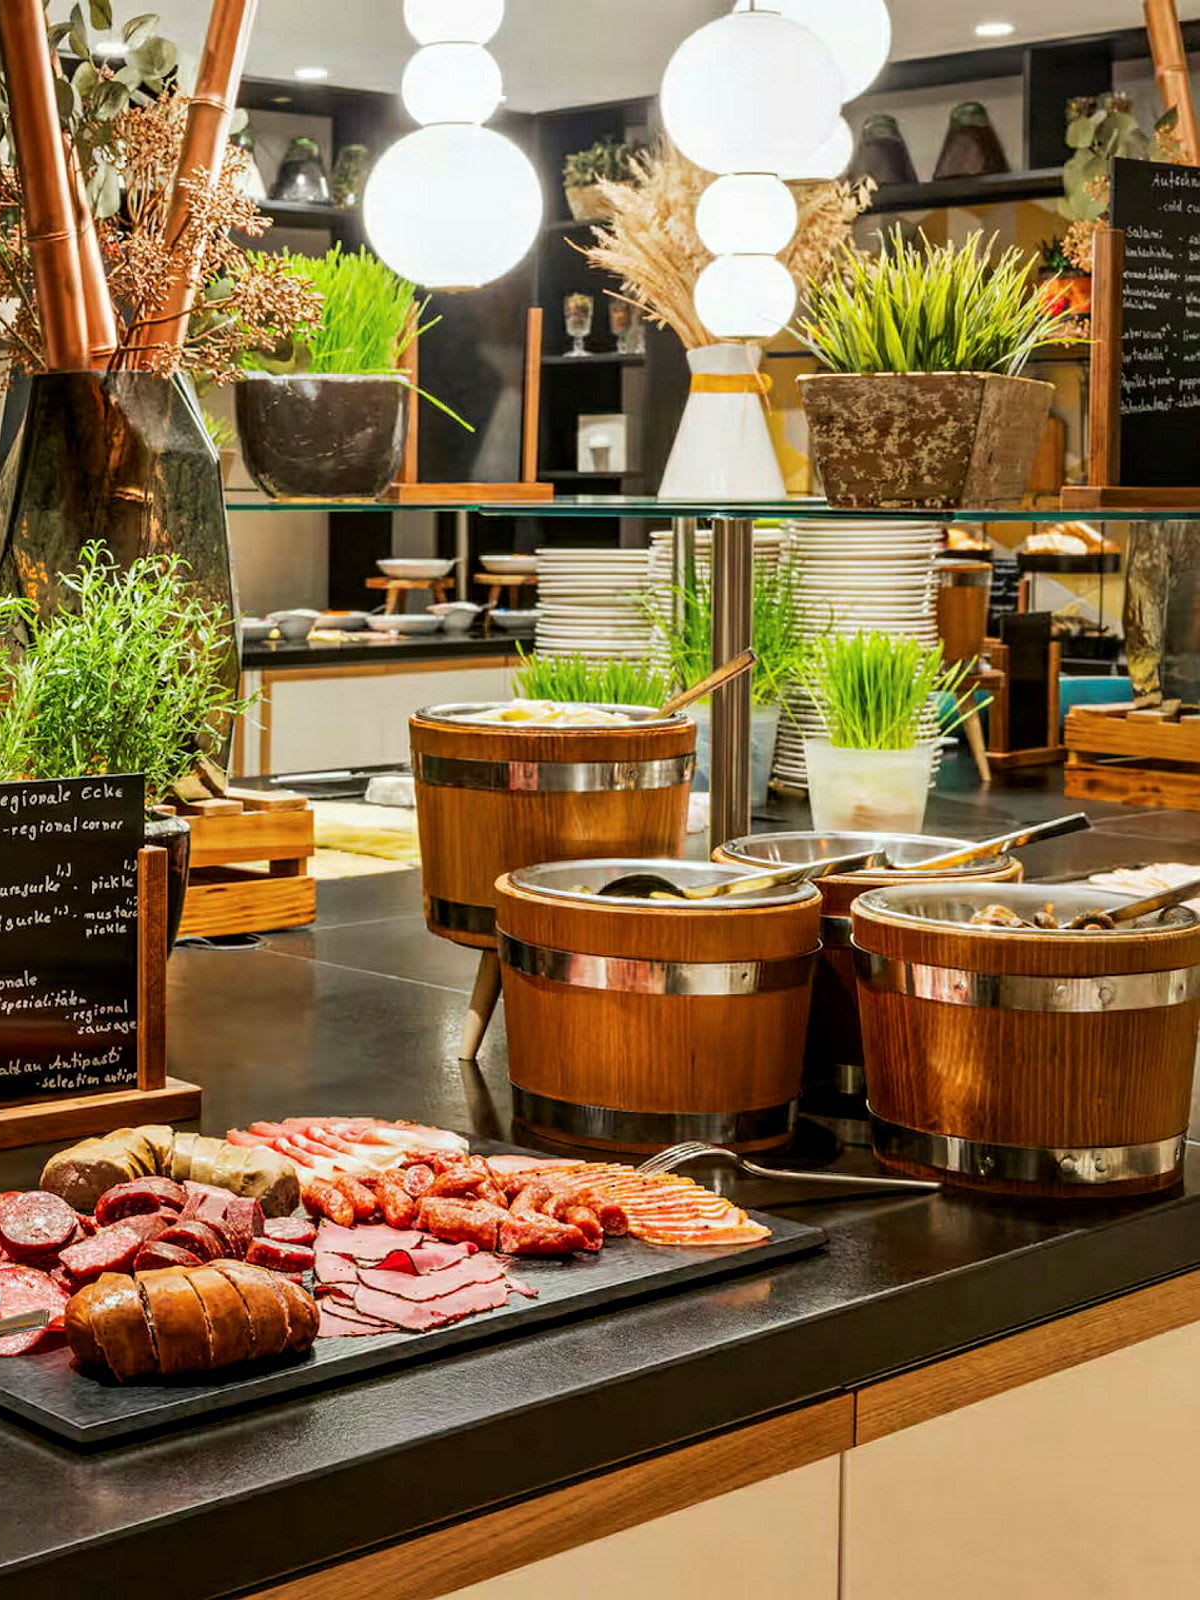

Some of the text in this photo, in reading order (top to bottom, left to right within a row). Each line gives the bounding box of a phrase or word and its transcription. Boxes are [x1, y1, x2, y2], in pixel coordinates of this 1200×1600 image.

[81, 782, 124, 801] Ecke
[81, 819, 124, 832] corner
[91, 875, 134, 894] pickle
[85, 923, 128, 939] pickle
[23, 1062, 43, 1073] an
[48, 1046, 123, 1071] Antipasti
